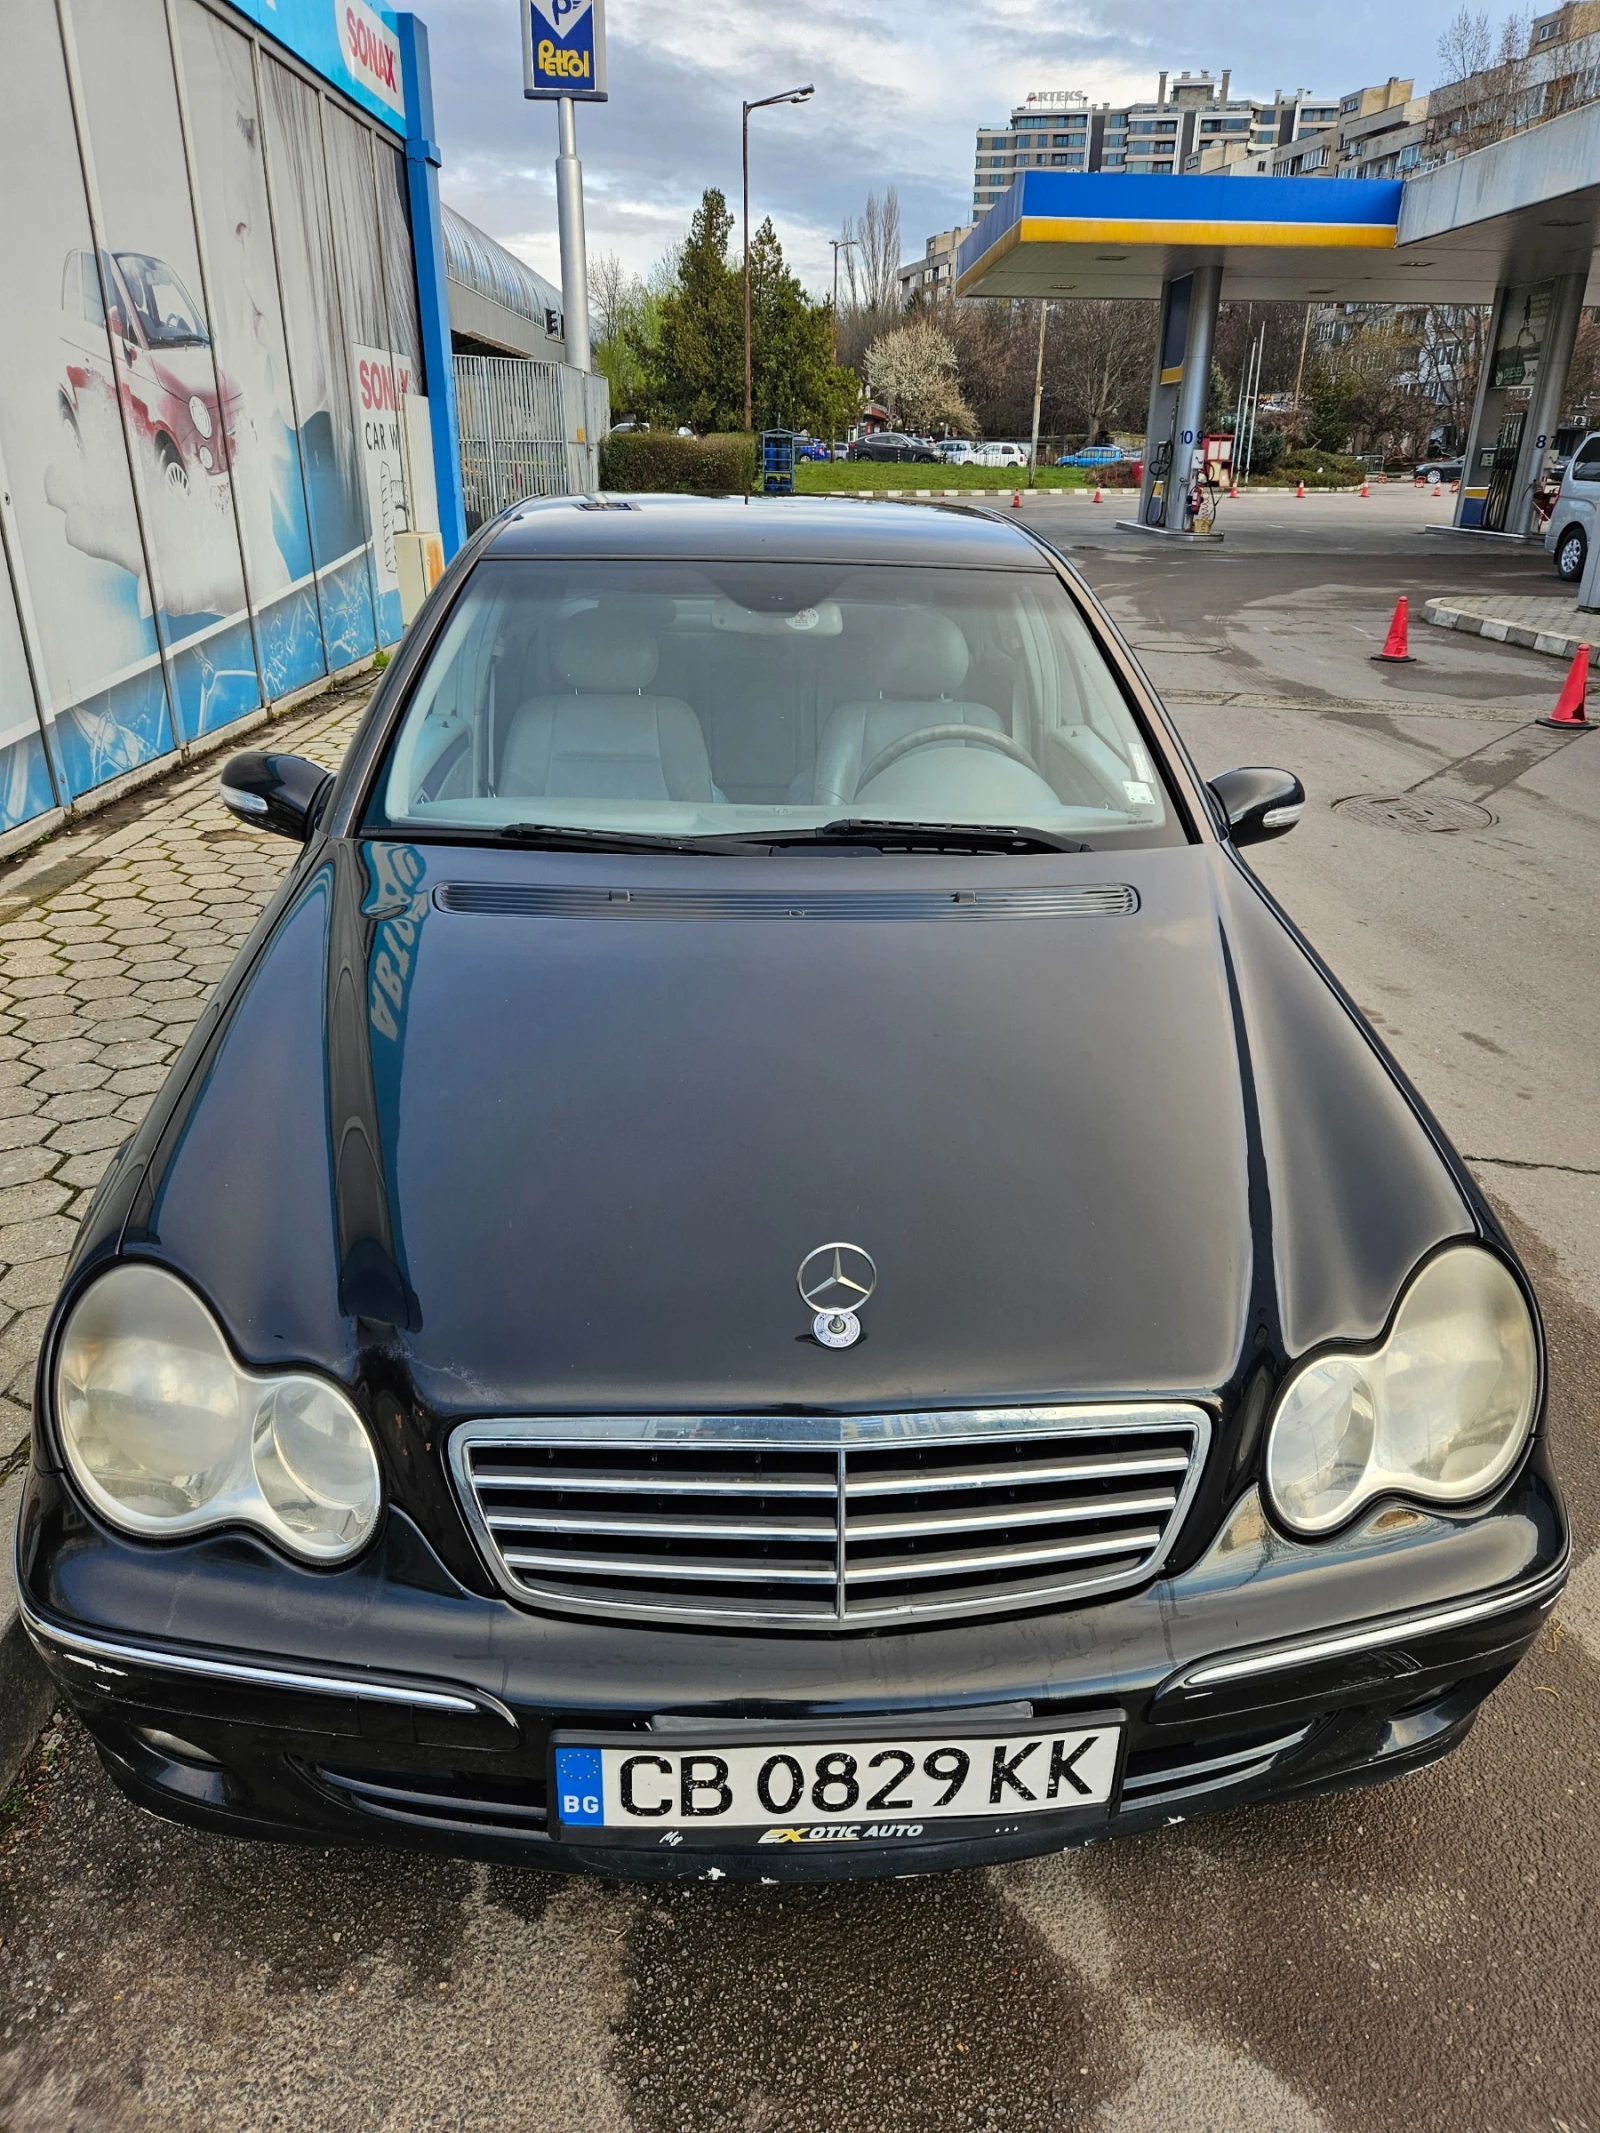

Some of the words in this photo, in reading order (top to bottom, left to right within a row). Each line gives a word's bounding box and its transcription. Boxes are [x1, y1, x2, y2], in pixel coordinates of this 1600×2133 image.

[346, 6, 397, 93] SONAX
[538, 39, 590, 78] Petrol
[1025, 90, 1083, 102] ARTEKS
[365, 421, 386, 451] CAR
[1180, 430, 1193, 444] 10
[1536, 434, 1547, 448] 8
[619, 1754, 733, 1817] CB
[756, 1747, 971, 1815] 0829
[989, 1735, 1100, 1804] KK
[563, 1794, 599, 1814] BG
[659, 1830, 684, 1848] My
[757, 1824, 861, 1844] EXOTIC
[863, 1823, 924, 1838] AUTO
